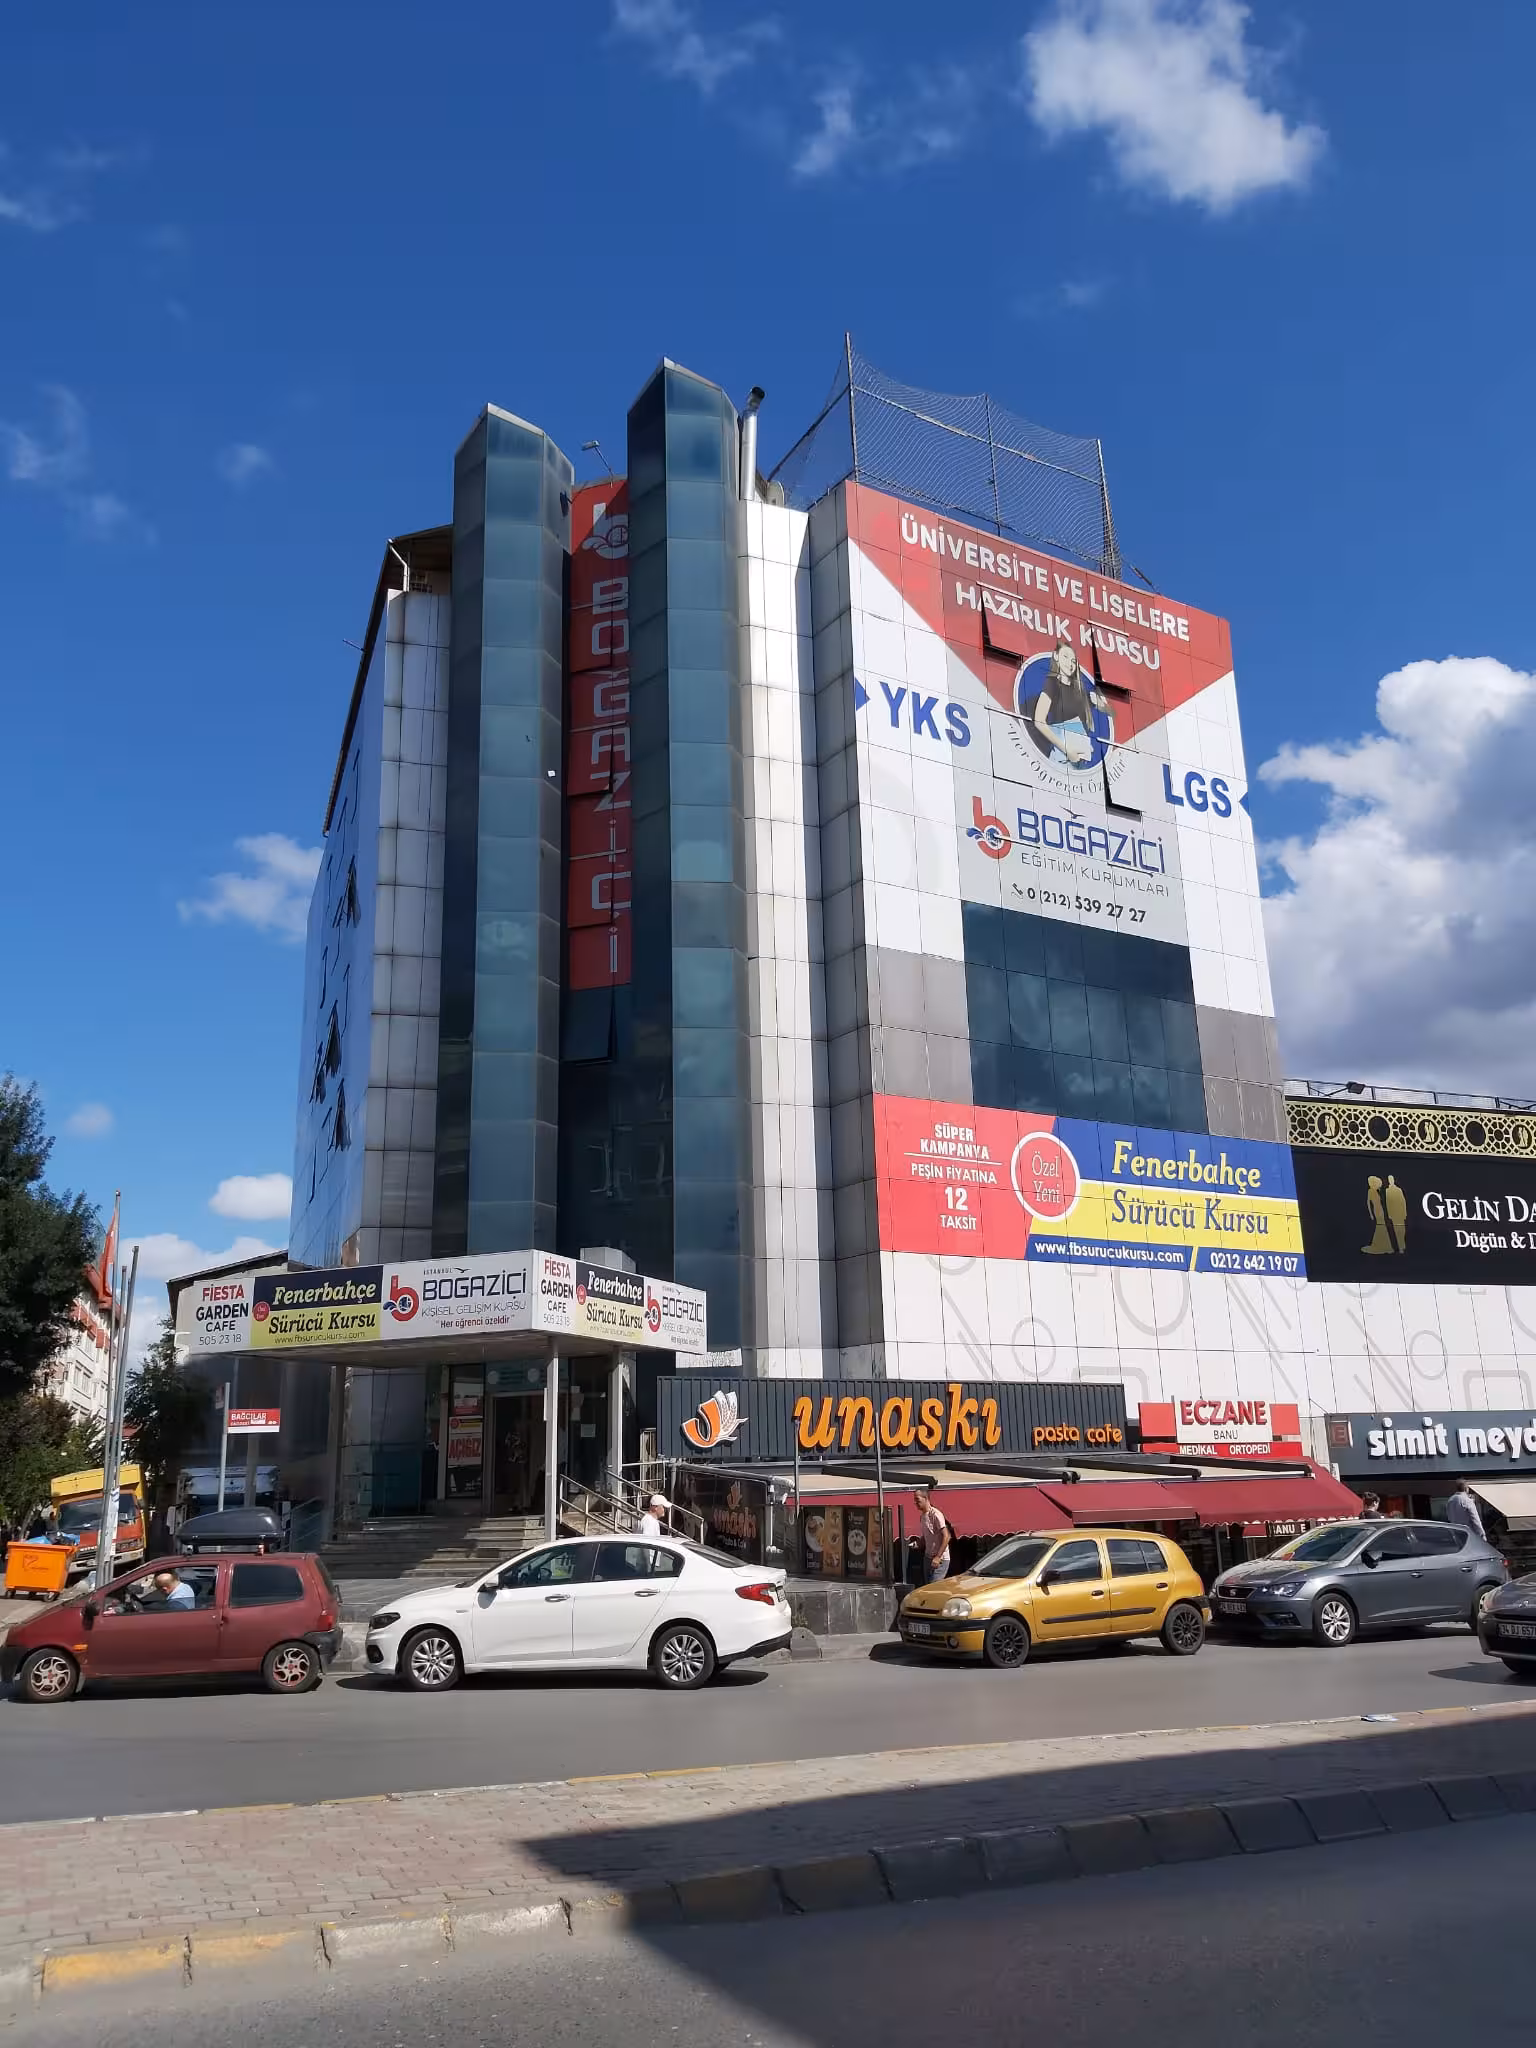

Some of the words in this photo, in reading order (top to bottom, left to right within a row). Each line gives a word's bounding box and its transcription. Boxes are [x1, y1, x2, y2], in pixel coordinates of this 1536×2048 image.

[902, 513, 1049, 592] ÜNİVERSİTE
[1054, 573, 1084, 604] VE
[1090, 585, 1191, 642] LİSELERE
[956, 582, 1072, 642] HAZIRLIK
[1080, 624, 1160, 670] KURSU
[879, 681, 971, 748] YKS
[1162, 763, 1232, 818] LGS
[1017, 807, 1165, 875] BOĞAZİÇİ
[1021, 851, 1074, 875] EĞİTİM
[1080, 866, 1169, 897] KURUMLARI
[1027, 887, 1036, 900] 0
[1039, 890, 1071, 910] (212)
[1074, 895, 1102, 914] 539
[1106, 902, 1124, 919] 27
[1129, 908, 1147, 923] 27
[934, 1122, 974, 1142] SÜPER
[920, 1138, 990, 1160] KAMPANYA
[911, 1161, 943, 1180] PEŞİN
[946, 1164, 998, 1185] FİYATINA
[1032, 1151, 1060, 1177] Özel
[1112, 1140, 1261, 1195] Fenerbahçe
[944, 1186, 969, 1211] 12
[1033, 1180, 1061, 1203] Yeni
[940, 1214, 977, 1231] TAKSİT
[1112, 1189, 1196, 1229] Sürücü
[1204, 1198, 1269, 1235] Kursu
[1454, 1229, 1508, 1254] Düğün
[1511, 1231, 1526, 1249] &
[544, 1256, 571, 1279] FİESTA
[1035, 1240, 1185, 1265] www.fbsurucukursu.com
[1210, 1252, 1240, 1270] 0212
[1243, 1254, 1265, 1271] 642
[1269, 1255, 1281, 1271] 19
[1284, 1257, 1299, 1273] 07
[202, 1283, 245, 1302] FİESTA
[272, 1280, 377, 1305] Fenerbahçe
[541, 1279, 574, 1300] GARDEN
[587, 1270, 643, 1304] Fenerbahçe
[195, 1302, 249, 1322] GARDEN
[547, 1300, 567, 1313] CAFE
[586, 1303, 617, 1325] Sürücü
[618, 1308, 643, 1330] Kursu
[205, 1320, 236, 1332] CAFE
[269, 1311, 323, 1334] Sürücü
[327, 1311, 376, 1330] Kursu
[199, 1336, 217, 1346] 505
[219, 1334, 230, 1345] 23
[231, 1412, 267, 1421] BAĞCILAR
[1180, 1400, 1268, 1426] ECZANE
[1032, 1422, 1080, 1447] pasta
[1086, 1423, 1123, 1443] cafe
[1213, 1429, 1239, 1440] BANU
[1368, 1417, 1449, 1457] simit
